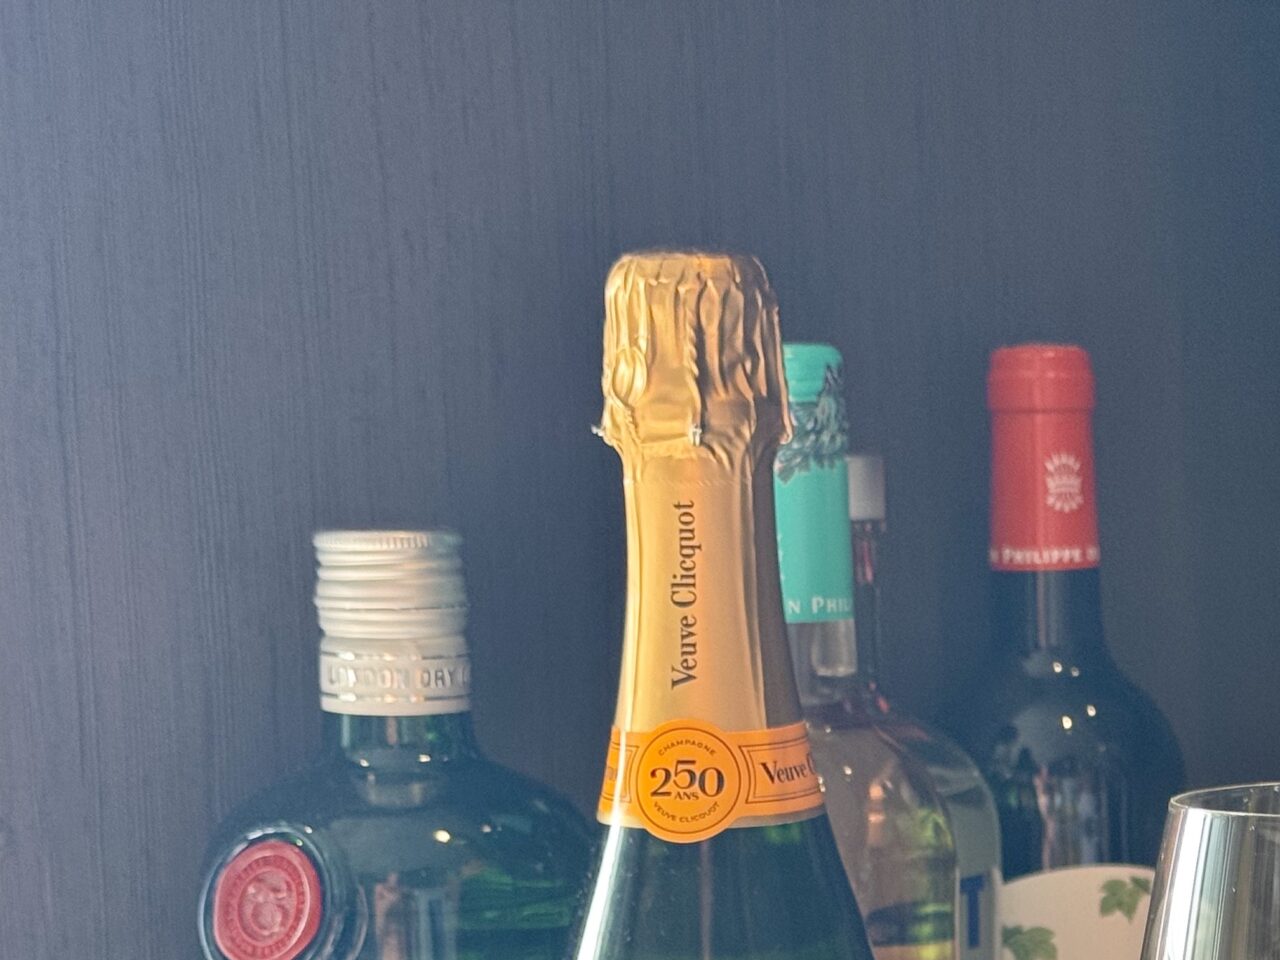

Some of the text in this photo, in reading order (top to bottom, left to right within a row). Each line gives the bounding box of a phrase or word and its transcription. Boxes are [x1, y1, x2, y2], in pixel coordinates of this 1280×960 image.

[671, 500, 703, 690] Veuve Clicquot
[328, 665, 411, 689] LONDON
[416, 668, 457, 689] DRY
[658, 739, 717, 757] CHAMPAGNE
[650, 759, 725, 798] 250
[760, 759, 807, 785] Veuve
[674, 791, 700, 801] ANS
[653, 801, 720, 824] VEUVE CLICQUOT
